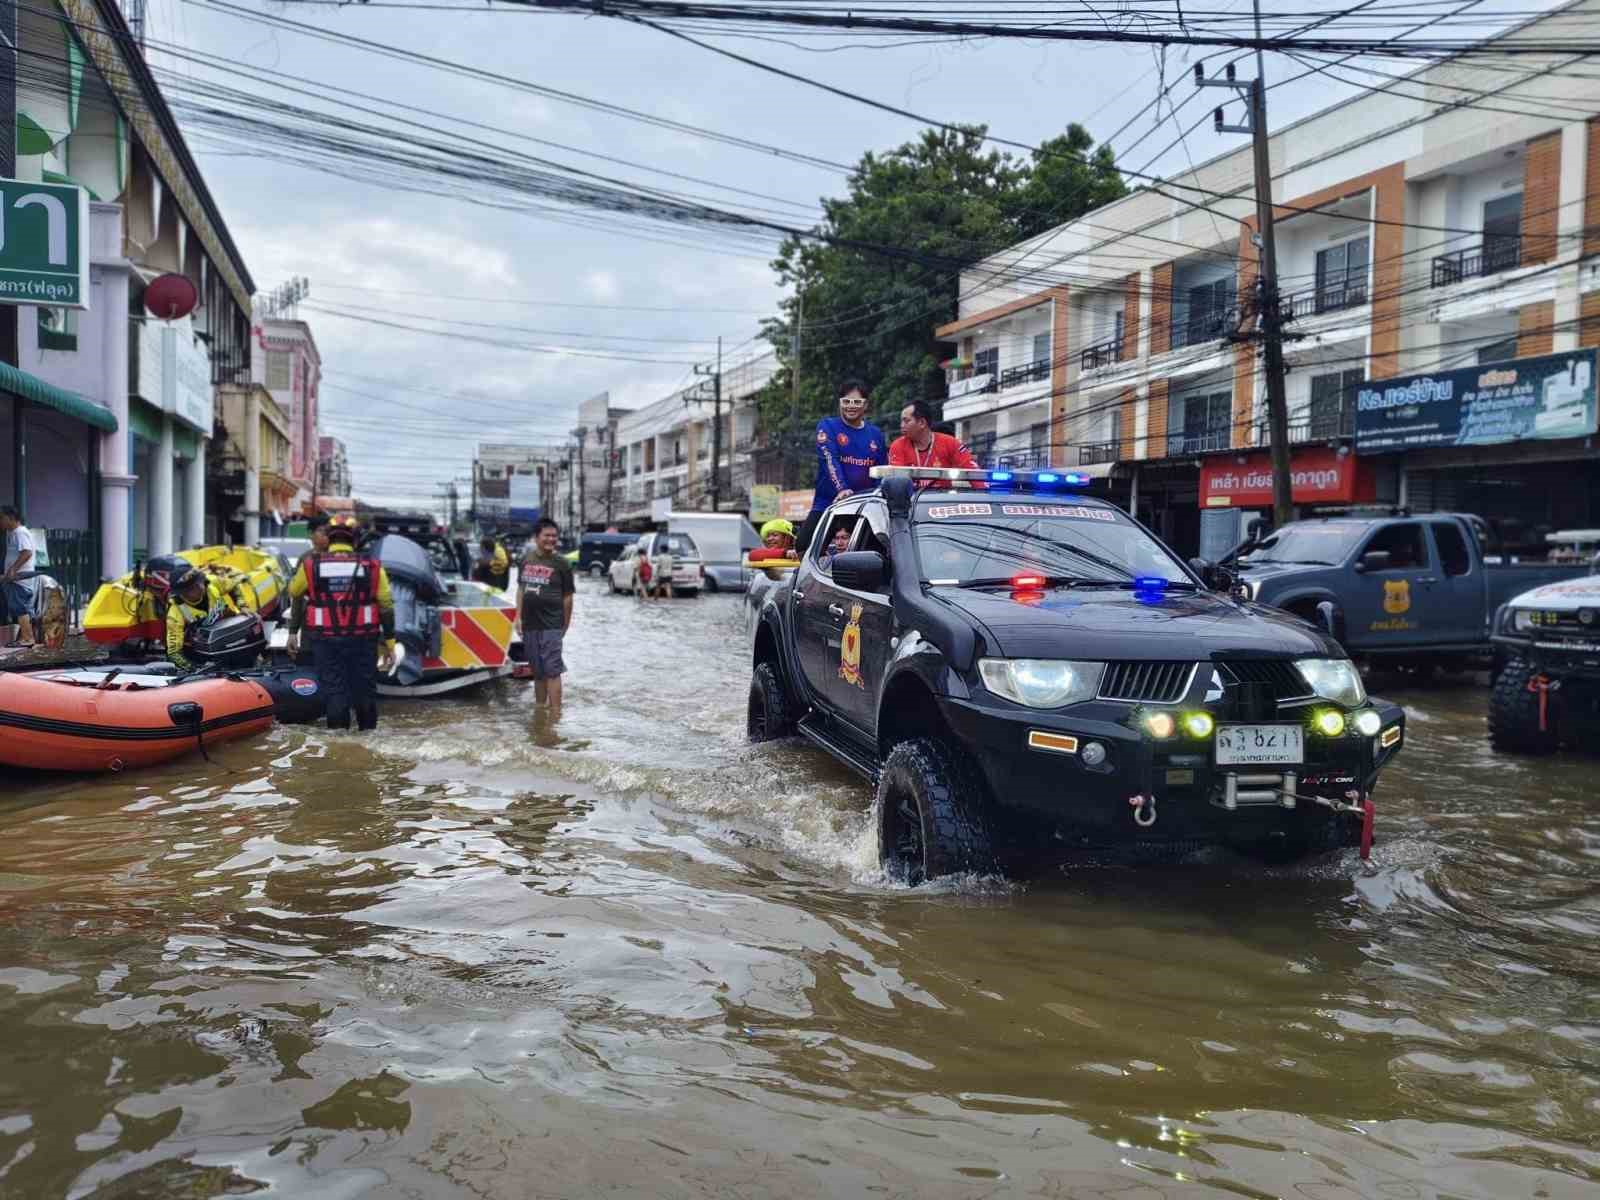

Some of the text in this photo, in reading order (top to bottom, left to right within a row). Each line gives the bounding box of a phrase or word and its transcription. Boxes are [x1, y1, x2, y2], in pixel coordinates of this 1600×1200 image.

[0, 190, 68, 266] า
[1211, 473, 1240, 489] เหล้า
[1290, 469, 1338, 489] าคาถูก
